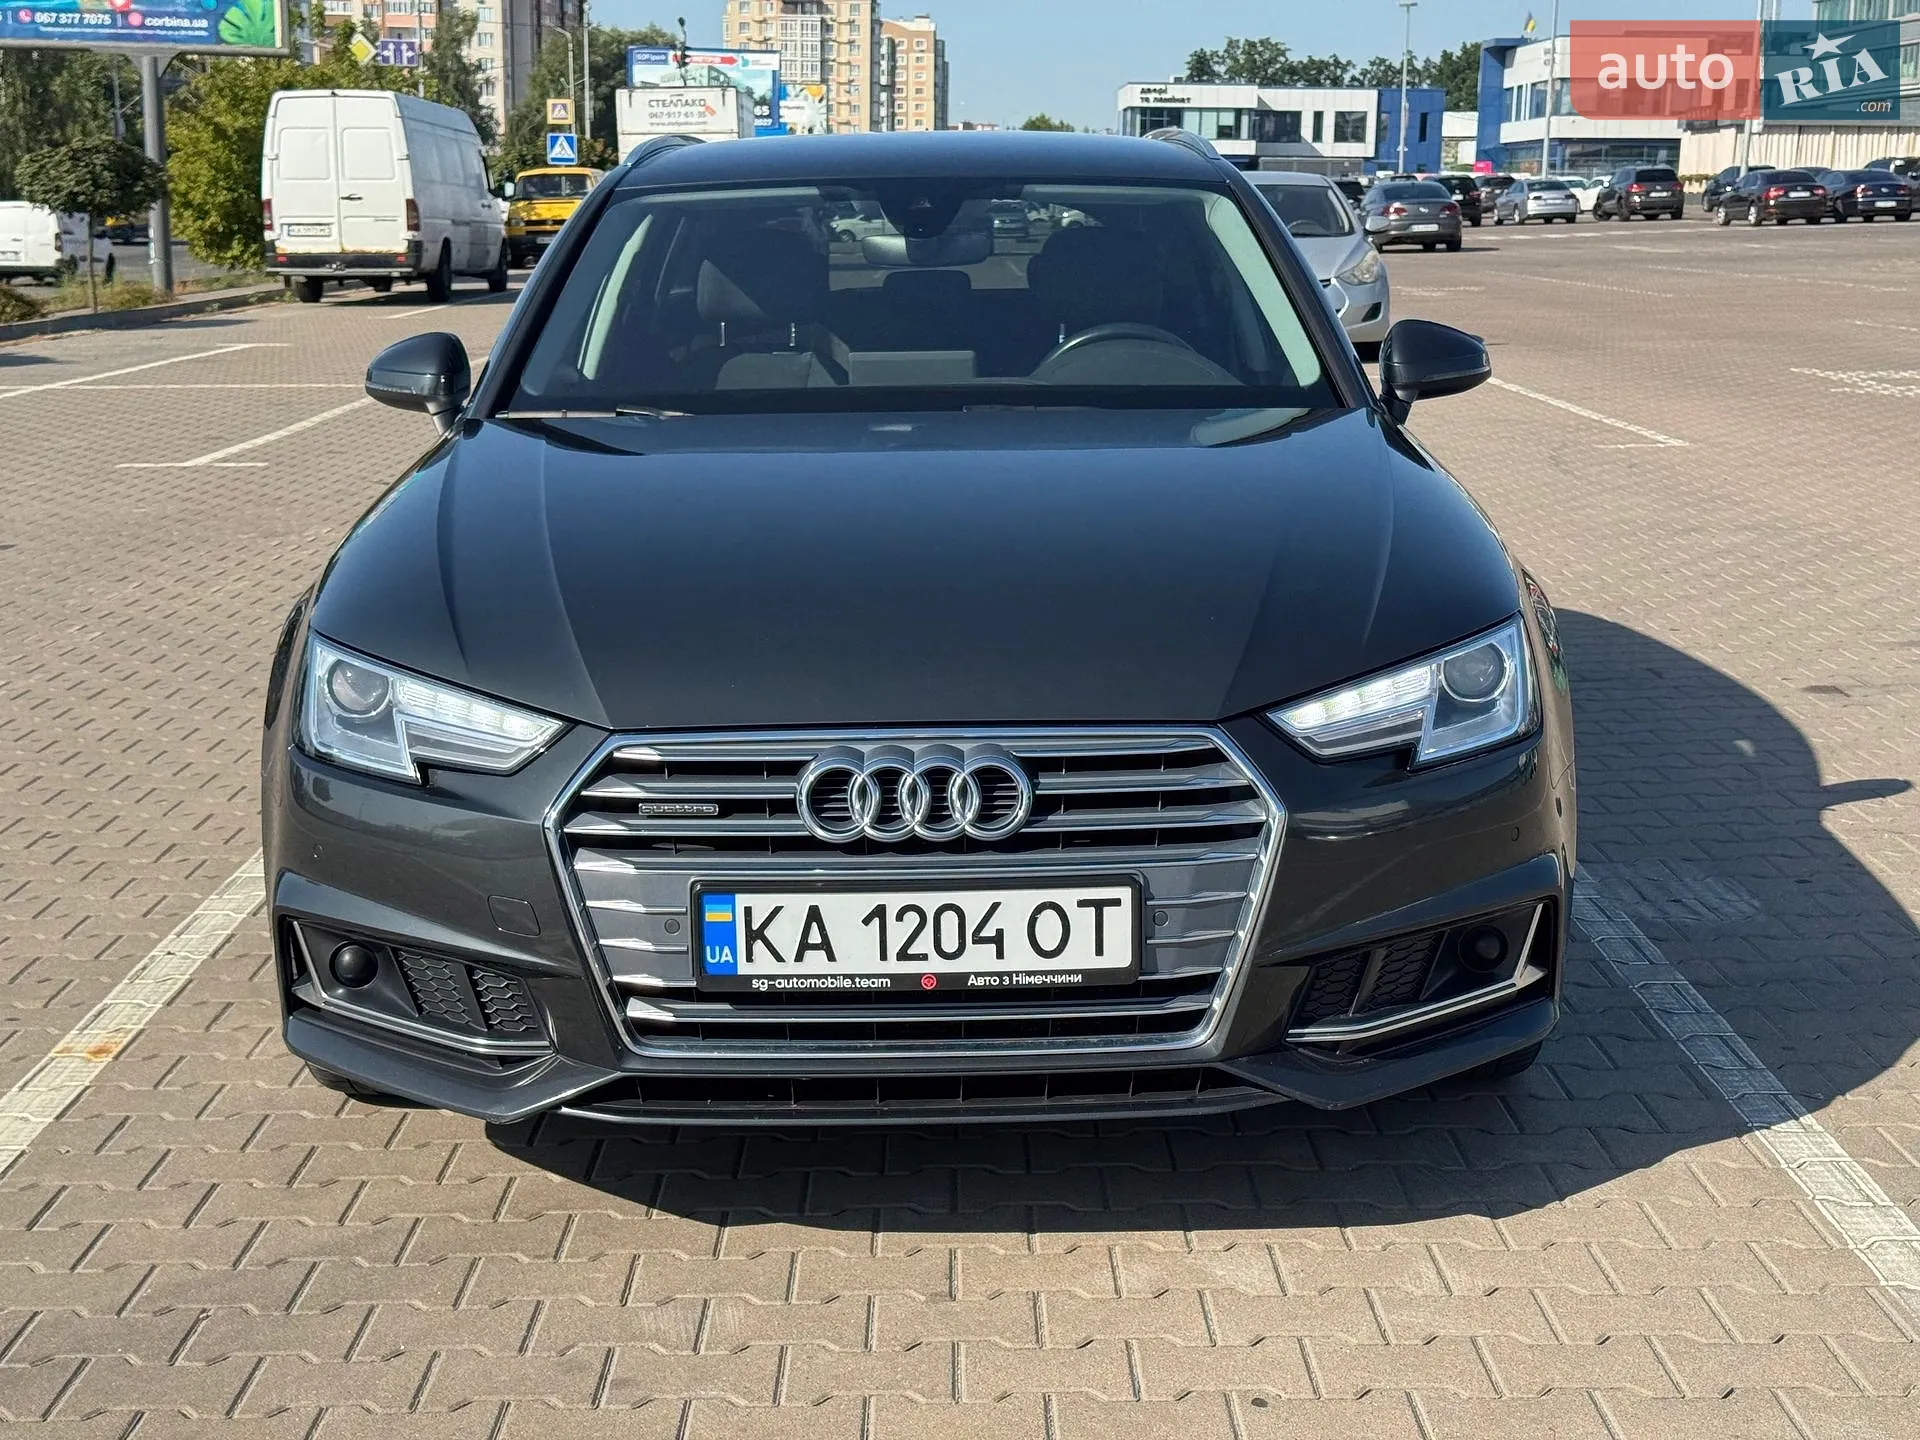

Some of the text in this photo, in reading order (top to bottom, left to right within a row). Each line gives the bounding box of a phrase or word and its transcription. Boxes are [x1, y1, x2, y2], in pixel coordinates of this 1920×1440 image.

[641, 804, 715, 814] quattro
[743, 897, 1122, 963] KA 1204 OT
[706, 947, 734, 964] UA
[751, 976, 891, 991] sg-automobile.team
[967, 971, 1082, 986] Авто з Німеччини
